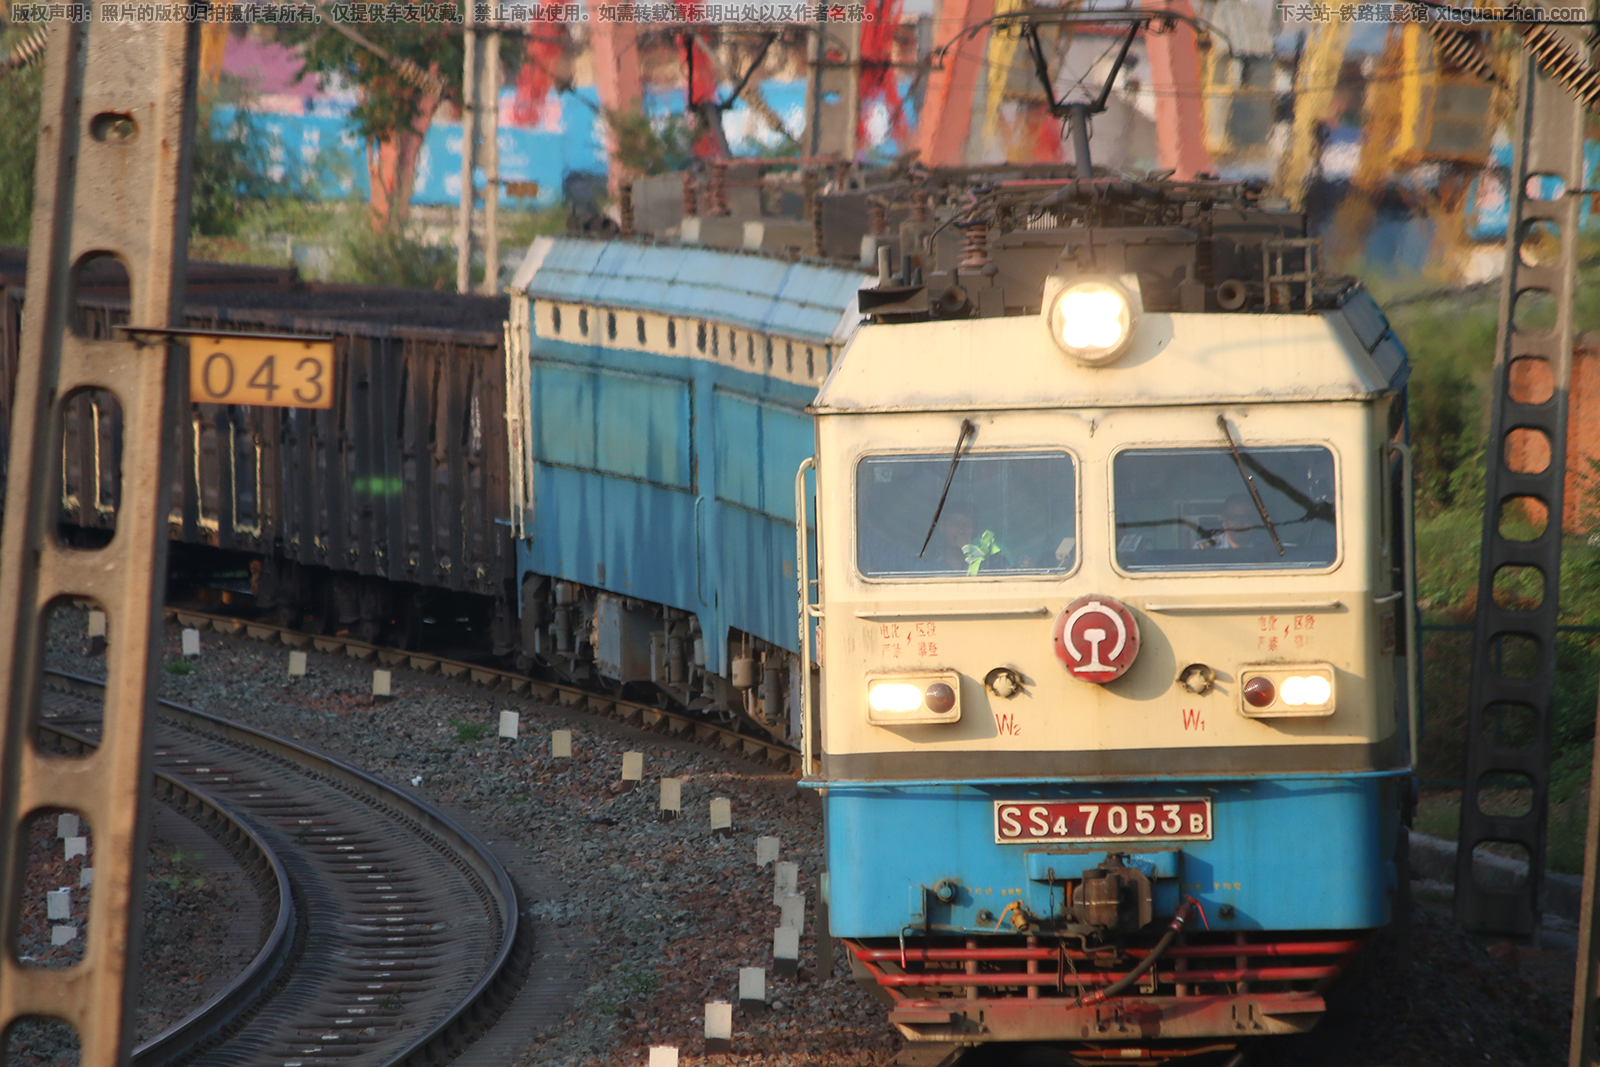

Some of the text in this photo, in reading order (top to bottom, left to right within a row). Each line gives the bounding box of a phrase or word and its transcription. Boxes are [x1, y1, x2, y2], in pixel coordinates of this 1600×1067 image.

[202, 352, 323, 404] 043
[995, 713, 1022, 736] W2
[1182, 708, 1206, 731] W1
[1001, 806, 1069, 837] SS4
